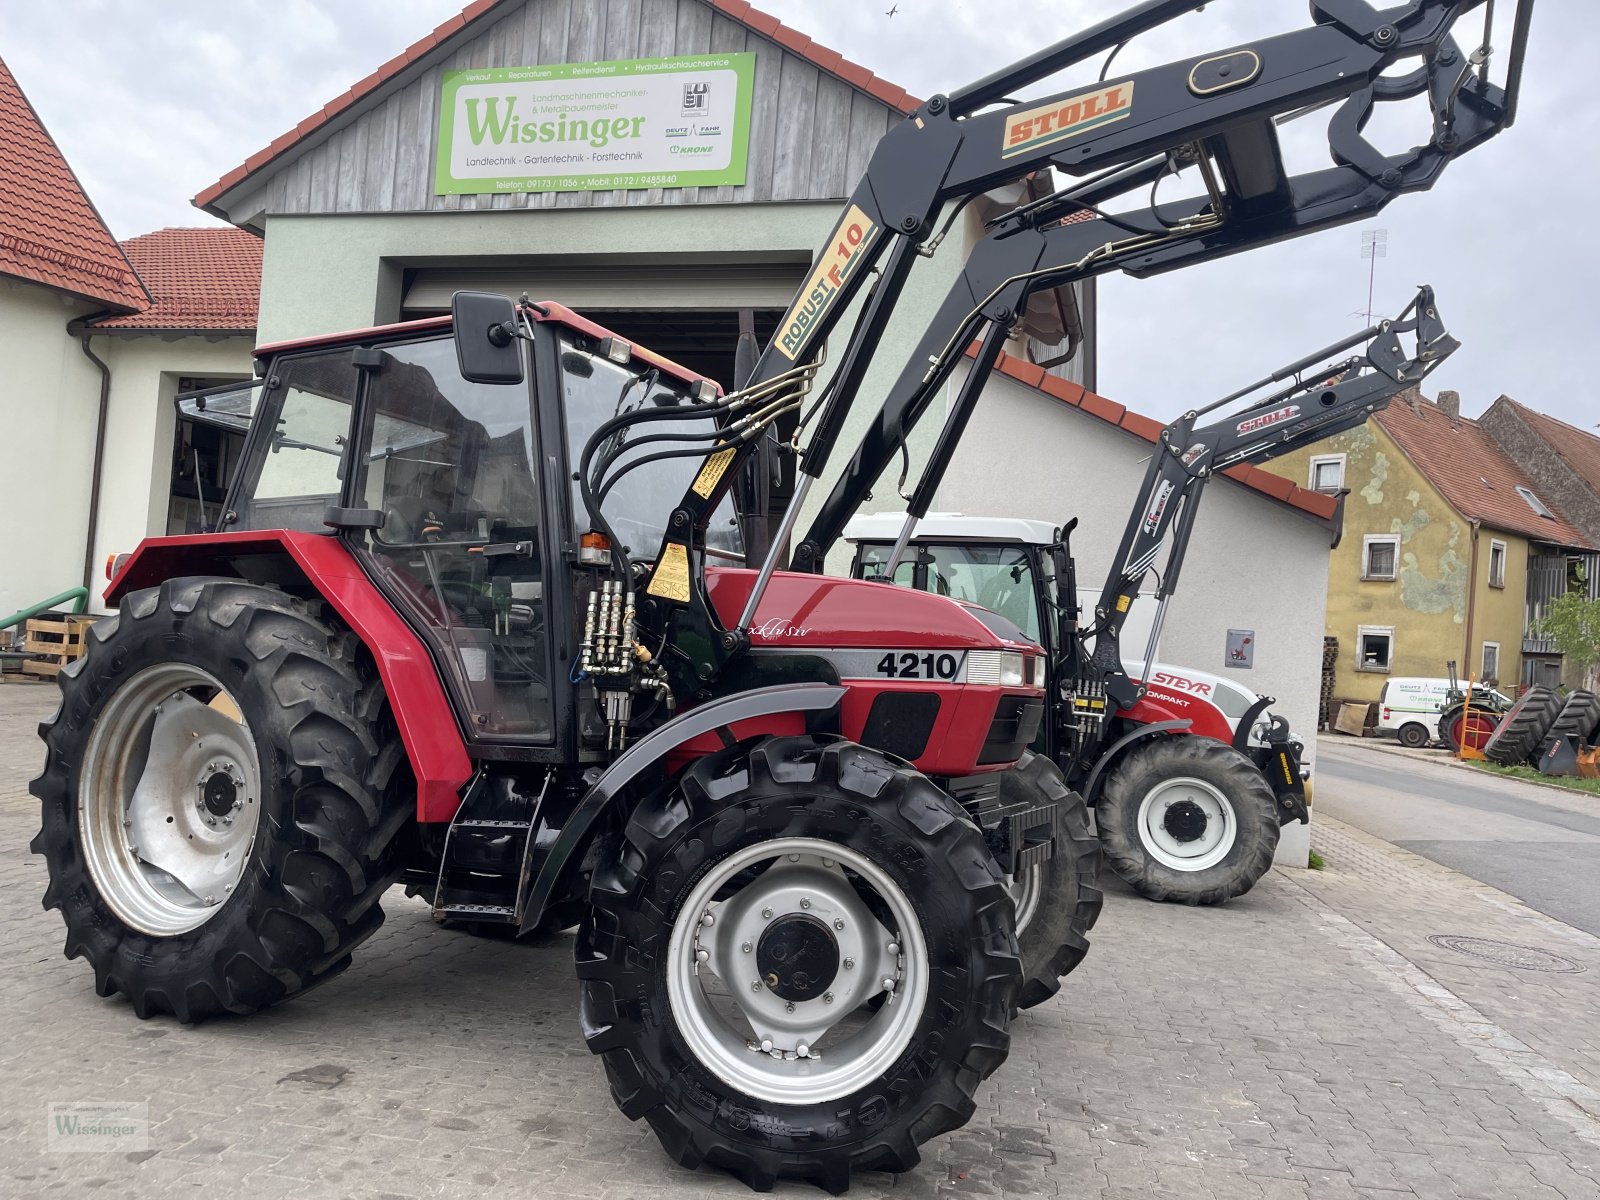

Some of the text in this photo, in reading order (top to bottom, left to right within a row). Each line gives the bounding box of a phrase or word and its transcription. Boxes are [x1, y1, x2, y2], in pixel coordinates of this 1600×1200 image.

[508, 70, 552, 79] Reparaturen
[572, 65, 616, 75] Reifendienst
[635, 59, 730, 73] Hydraulikschlauchservice
[532, 88, 648, 102] Landmaschinenmechaniker-
[532, 102, 618, 114] & Metallbauermeister
[1010, 88, 1126, 145] STOLL
[464, 96, 646, 148] Wissinger
[466, 156, 516, 166] Landtechnik
[524, 153, 584, 165] Gartentechnik
[592, 151, 643, 162] Forsttechnik
[680, 145, 714, 154] KRONE
[496, 180, 524, 190] Telefon:
[526, 180, 551, 188] 09173
[559, 179, 578, 188] 1056
[587, 178, 611, 186] Mobil:
[613, 176, 634, 186] 0172
[640, 175, 677, 184] 9485840
[781, 223, 863, 352] ROBUST F 10
[1240, 407, 1297, 433] STOLL
[747, 617, 812, 638] xklusiv
[877, 652, 957, 679] 4210
[1152, 672, 1212, 696] STEYR
[1146, 690, 1191, 708] OMPAKT
